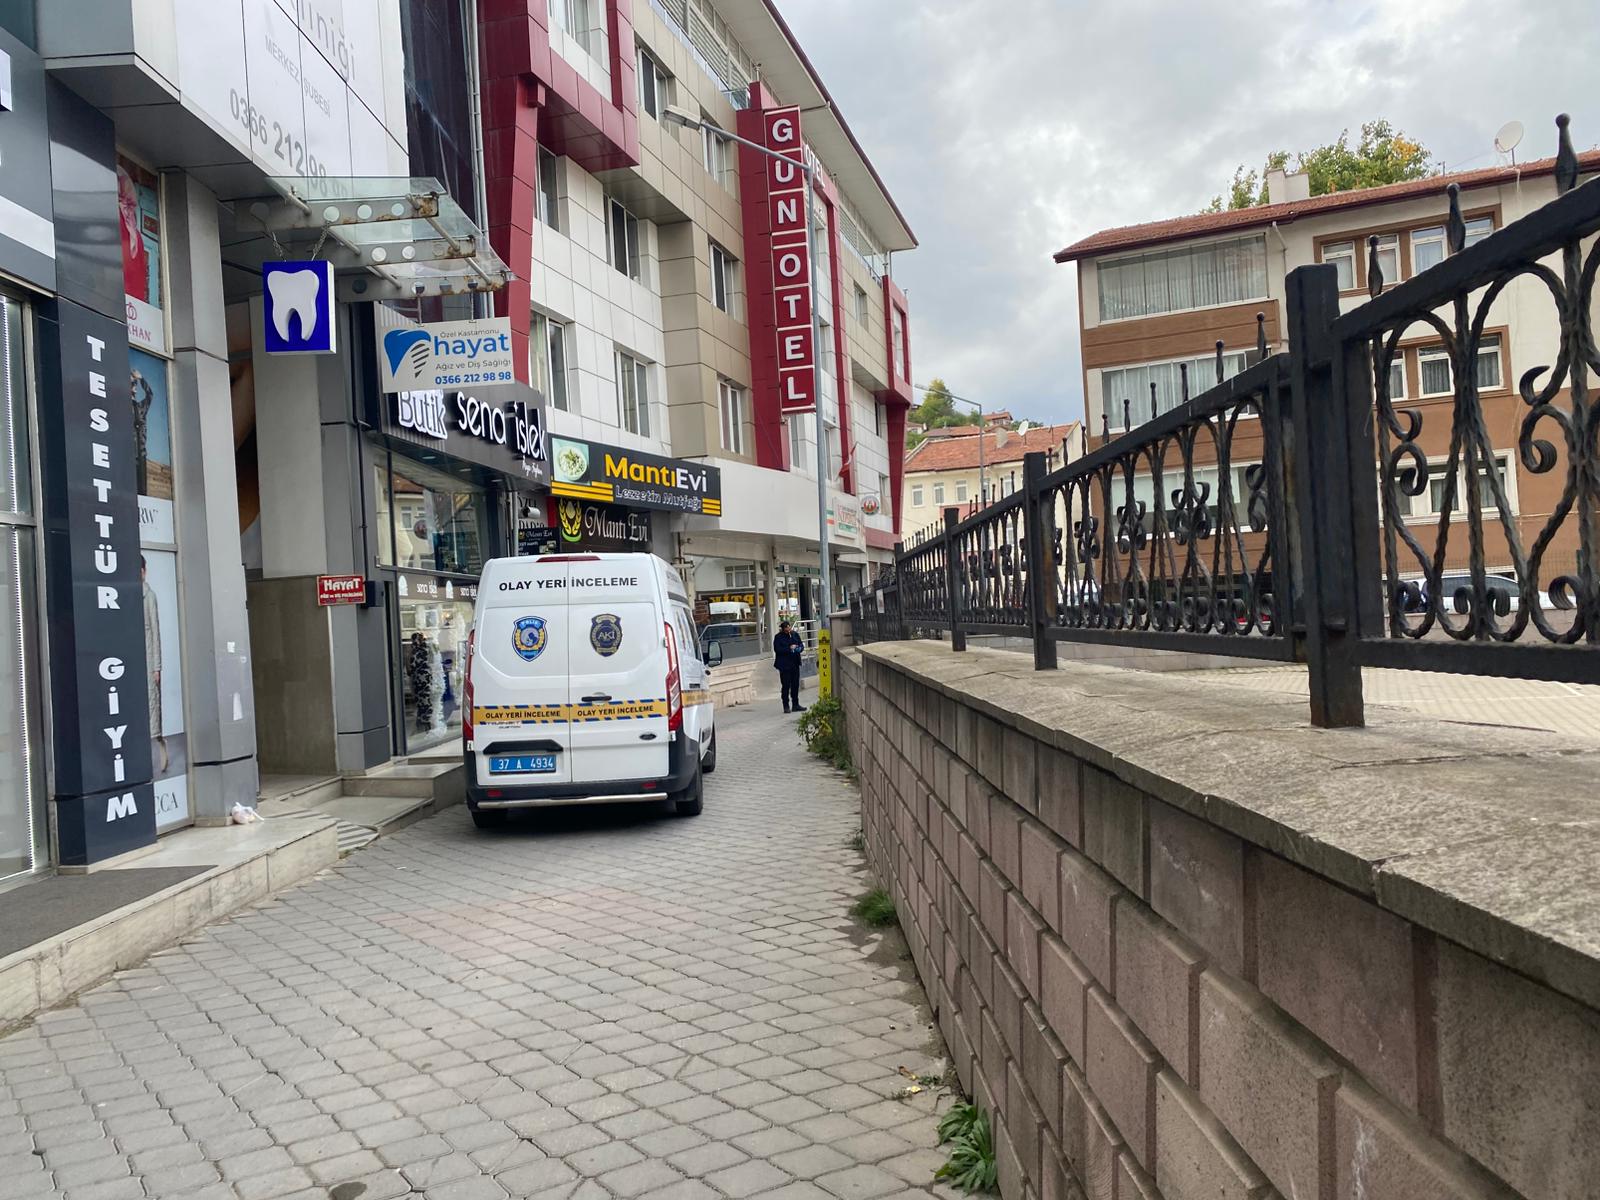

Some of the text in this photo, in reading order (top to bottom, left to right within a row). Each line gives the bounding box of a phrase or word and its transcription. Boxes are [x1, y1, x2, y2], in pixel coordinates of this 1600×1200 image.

[265, 35, 301, 84] MERKEZ
[230, 88, 268, 145] 0366
[273, 121, 305, 178] 212
[440, 328, 500, 339] Özel Kastamonu
[779, 254, 807, 401] OTEL
[434, 333, 510, 359] hayat
[435, 371, 512, 385] 0366 212 98 98
[436, 363, 454, 371] Ağız
[468, 361, 481, 370] Diş
[483, 360, 512, 368] Sağlığı
[399, 390, 448, 439] Butik
[457, 391, 507, 445] sena
[604, 453, 707, 493] MantıEvi
[616, 485, 702, 512] Lezzetin Mutfağı
[584, 506, 648, 542] Mantı Evi
[87, 335, 138, 823] TESETTÜR GİYİM
[323, 578, 361, 591] HAYAT
[499, 576, 639, 591] OLAY YERİ İNCELEME
[485, 710, 561, 719] OLAY YERİ İNCELEME
[577, 705, 654, 717] OLAY YERİ İNCELEME
[498, 756, 555, 770] 37 A 4934
